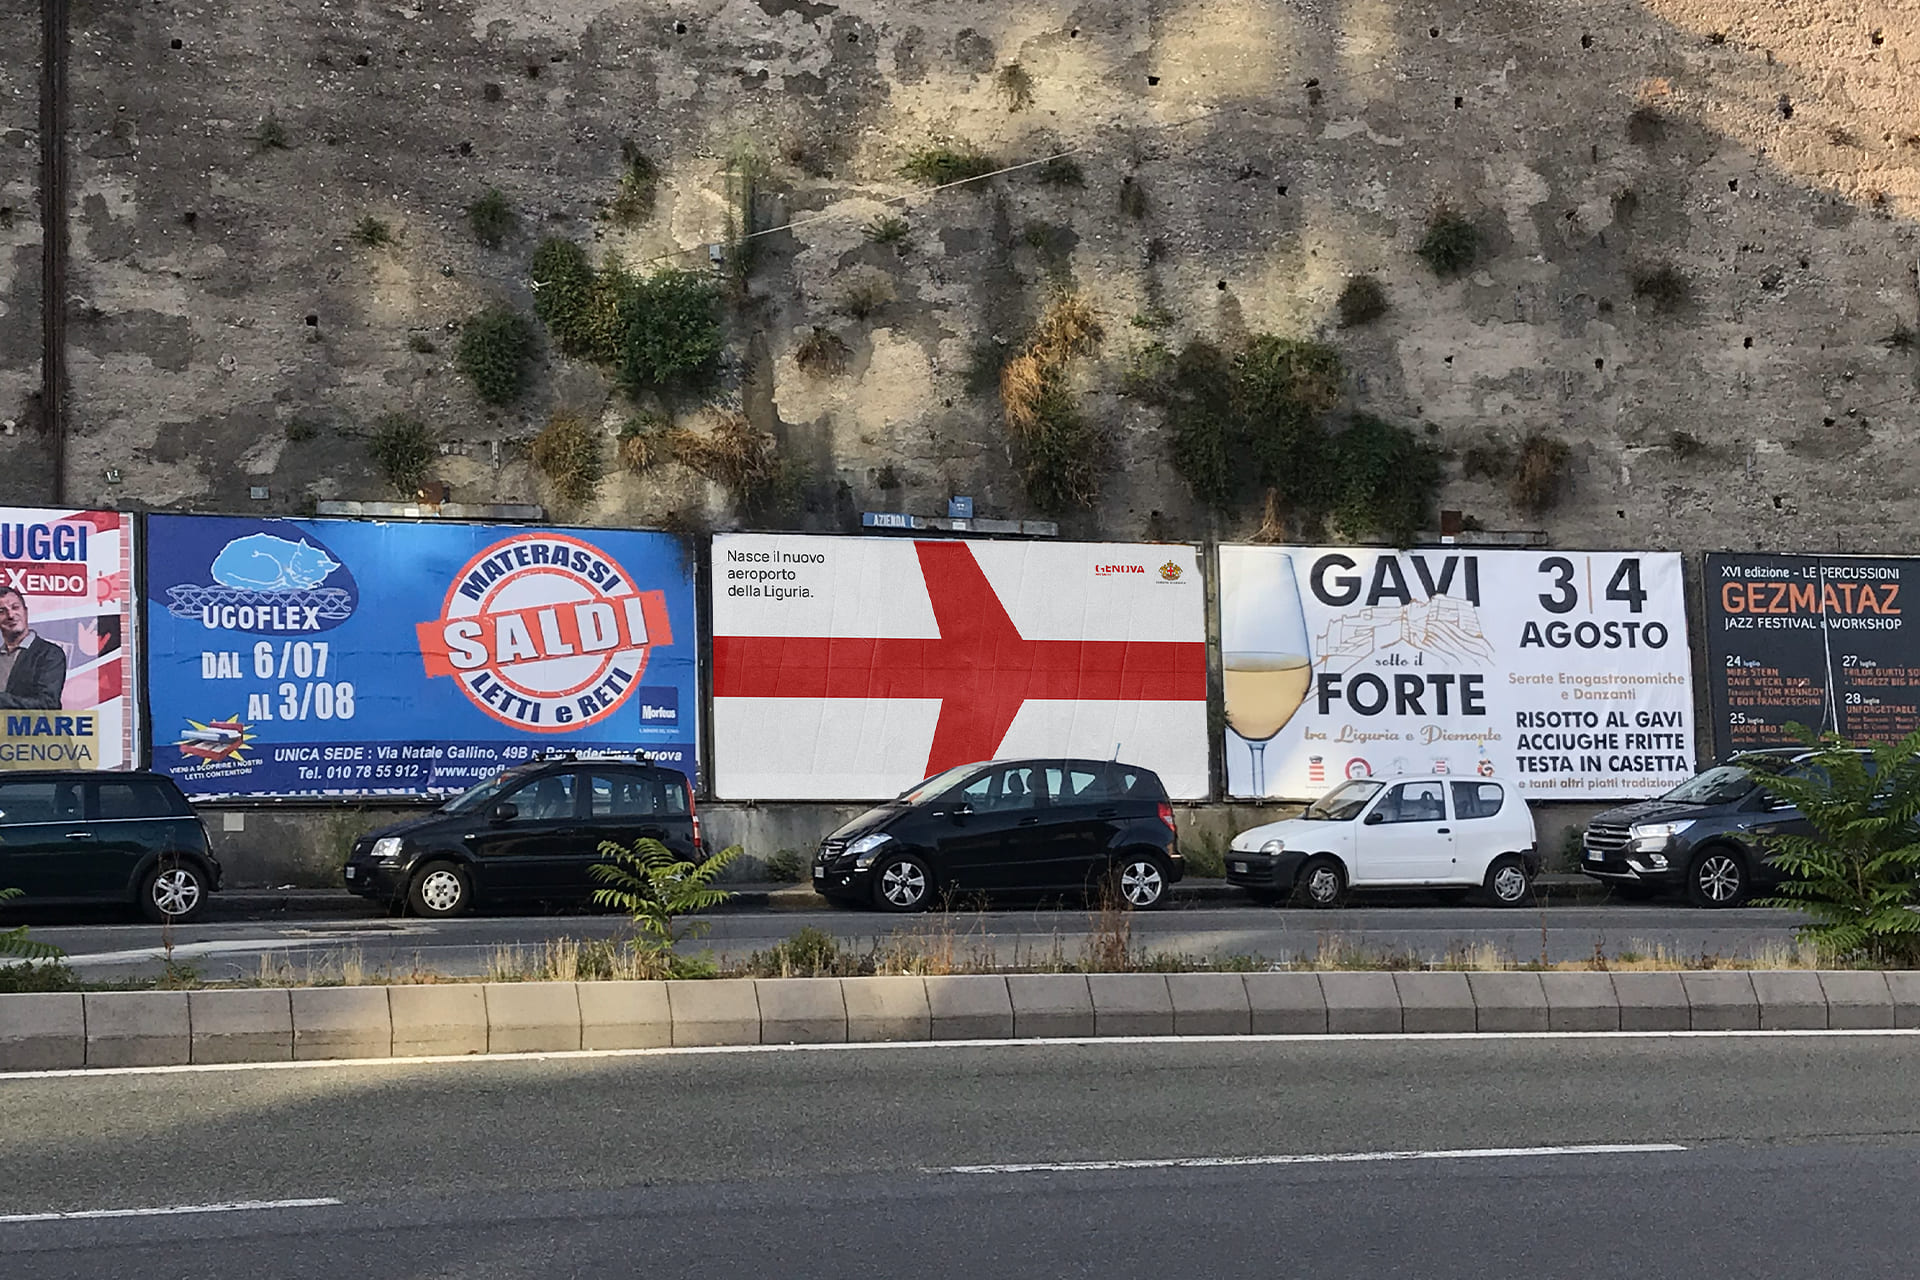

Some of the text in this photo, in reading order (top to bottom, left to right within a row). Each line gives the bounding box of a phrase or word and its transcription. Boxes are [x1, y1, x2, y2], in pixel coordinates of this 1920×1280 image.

[873, 514, 906, 527] AZIENDA
[726, 549, 825, 564] Nasce il nuovo
[459, 544, 621, 601] MATERASSI
[727, 567, 796, 584] aeroporto
[1095, 564, 1145, 574] GENOVA
[1721, 566, 1741, 578] XVI
[1745, 566, 1790, 578] edizione
[1802, 567, 1817, 579] LE
[1819, 567, 1900, 580] PERCUSSIONI
[1310, 553, 1481, 608] GAVI
[1538, 556, 1648, 614] 3 4
[727, 584, 814, 601] della Liguria.
[1721, 582, 1902, 615] GEZMATAZ
[202, 605, 321, 631] UGOFLEX
[1725, 617, 1754, 630] JAZZ
[1758, 617, 1817, 630] FESTIVAL
[1829, 618, 1902, 630] WORKSHOP
[443, 597, 649, 669] SALDI
[1519, 620, 1669, 650] AGOSTO
[202, 641, 329, 680] DAL 6/07
[1375, 651, 1423, 667] sotto il
[1726, 655, 1742, 667] 24
[1842, 655, 1858, 667] 27
[1508, 672, 1685, 687] Serate Enogastronomiche
[247, 682, 355, 721] AL 3/08
[470, 667, 633, 723] LETTI e RETI
[1317, 672, 1486, 716] FORTE
[1560, 688, 1636, 700] e Danzanti
[1844, 692, 1861, 704] 28
[7, 715, 94, 737] MARE
[1516, 711, 1683, 728] RISOTTO AL GAVI
[1730, 712, 1746, 724] 25
[1304, 724, 1503, 745] tra Liguria e Piemonte
[1517, 733, 1684, 750] ACCIUGHE FRITTE
[0, 743, 92, 761] GENOVA
[274, 748, 320, 761] UNICA
[323, 747, 364, 761] SEDE
[376, 746, 400, 760] Via
[402, 745, 444, 760] Natale
[447, 745, 499, 762] Gallino,
[503, 746, 528, 760] 49B
[299, 766, 323, 779] Tel.
[327, 765, 351, 779] 010
[355, 765, 372, 778] 78
[376, 765, 392, 778] 55
[394, 765, 419, 778] 912
[1515, 755, 1689, 773] TESTA IN CASETTA
[1529, 778, 1557, 788] tanti
[1560, 778, 1584, 788] altri
[1588, 778, 1618, 790] piatti
[1621, 777, 1690, 789] tradiziona
